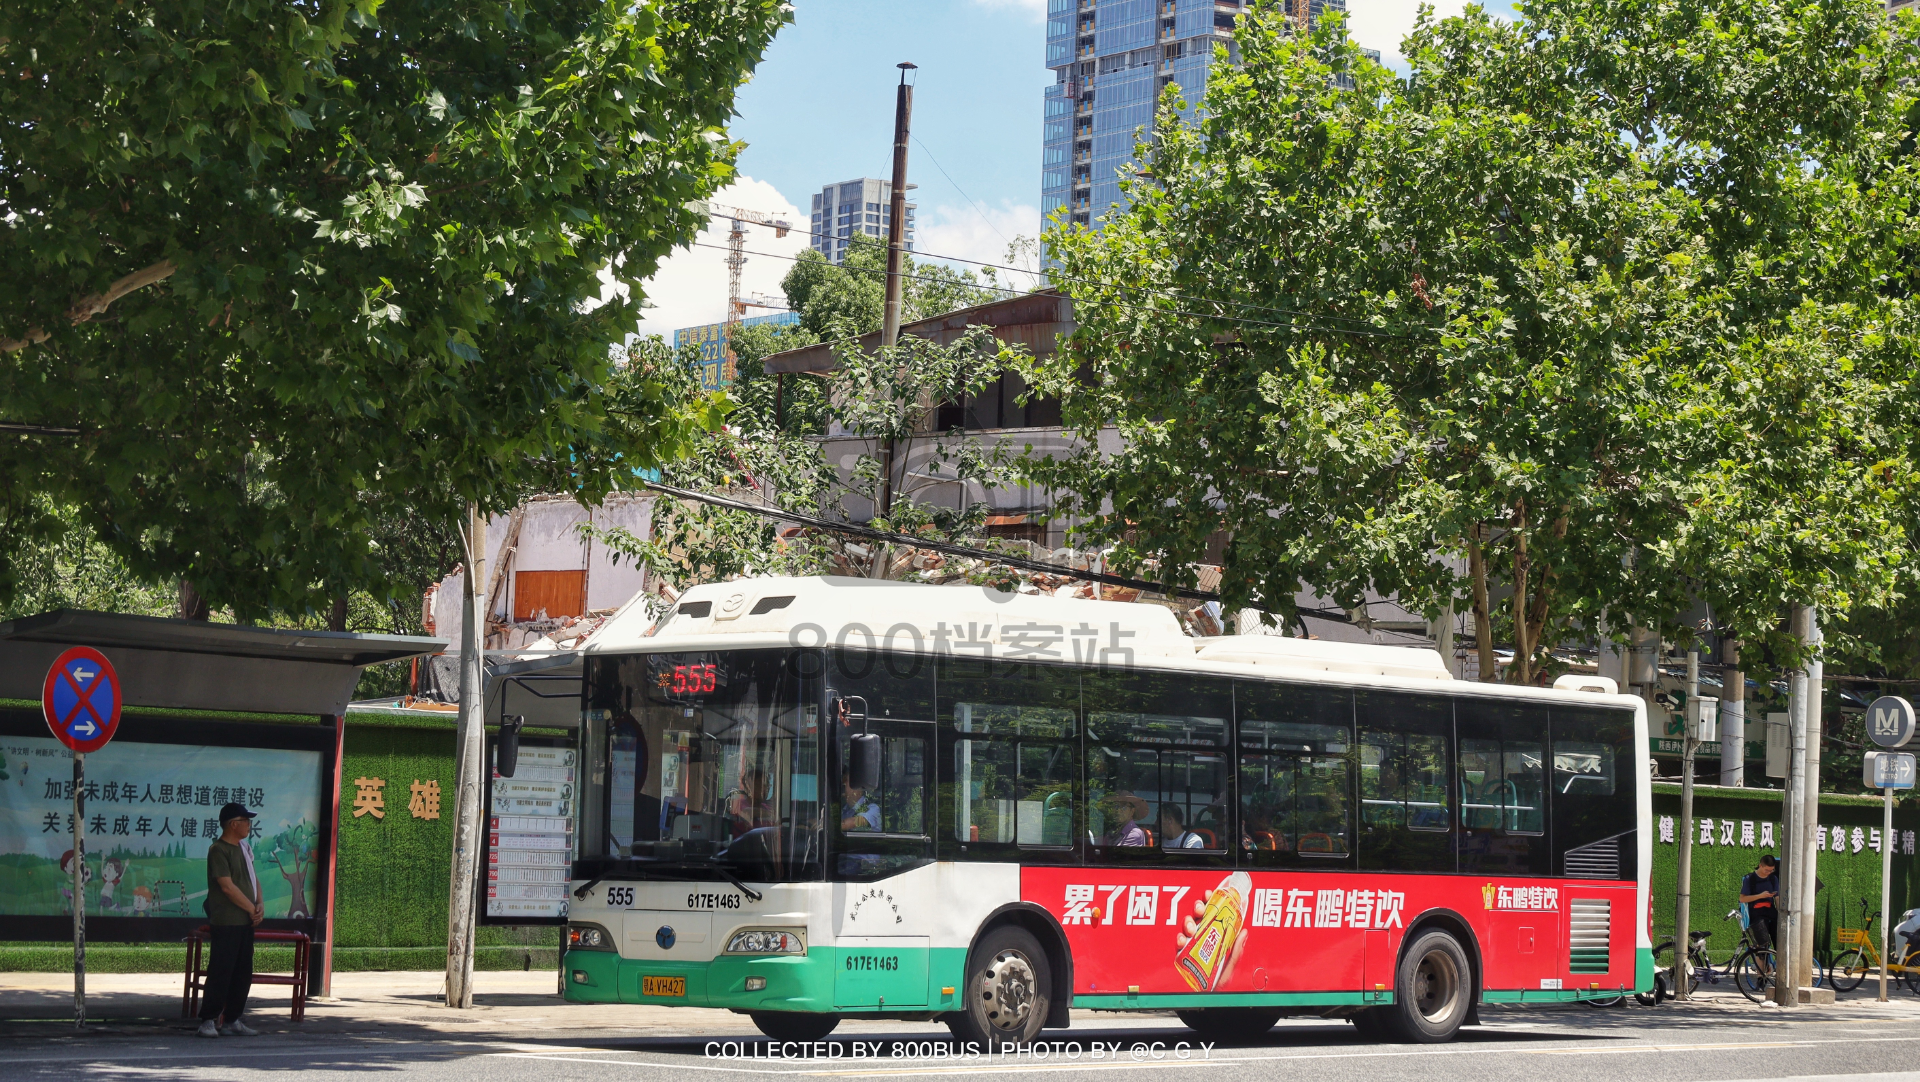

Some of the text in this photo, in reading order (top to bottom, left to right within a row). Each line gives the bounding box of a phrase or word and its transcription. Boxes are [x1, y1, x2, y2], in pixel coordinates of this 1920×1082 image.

[673, 665, 716, 693] 555
[1880, 758, 1899, 772] 地铁
[352, 776, 441, 820] 英雄
[42, 811, 263, 839] 关未成年人健康长
[607, 887, 634, 906] 555
[687, 893, 740, 909] 617E1463
[1063, 884, 1405, 929] 累了困了 喝东鹏特饮
[1497, 885, 1559, 910] 东鹏特饮
[846, 955, 899, 972] 617E1463
